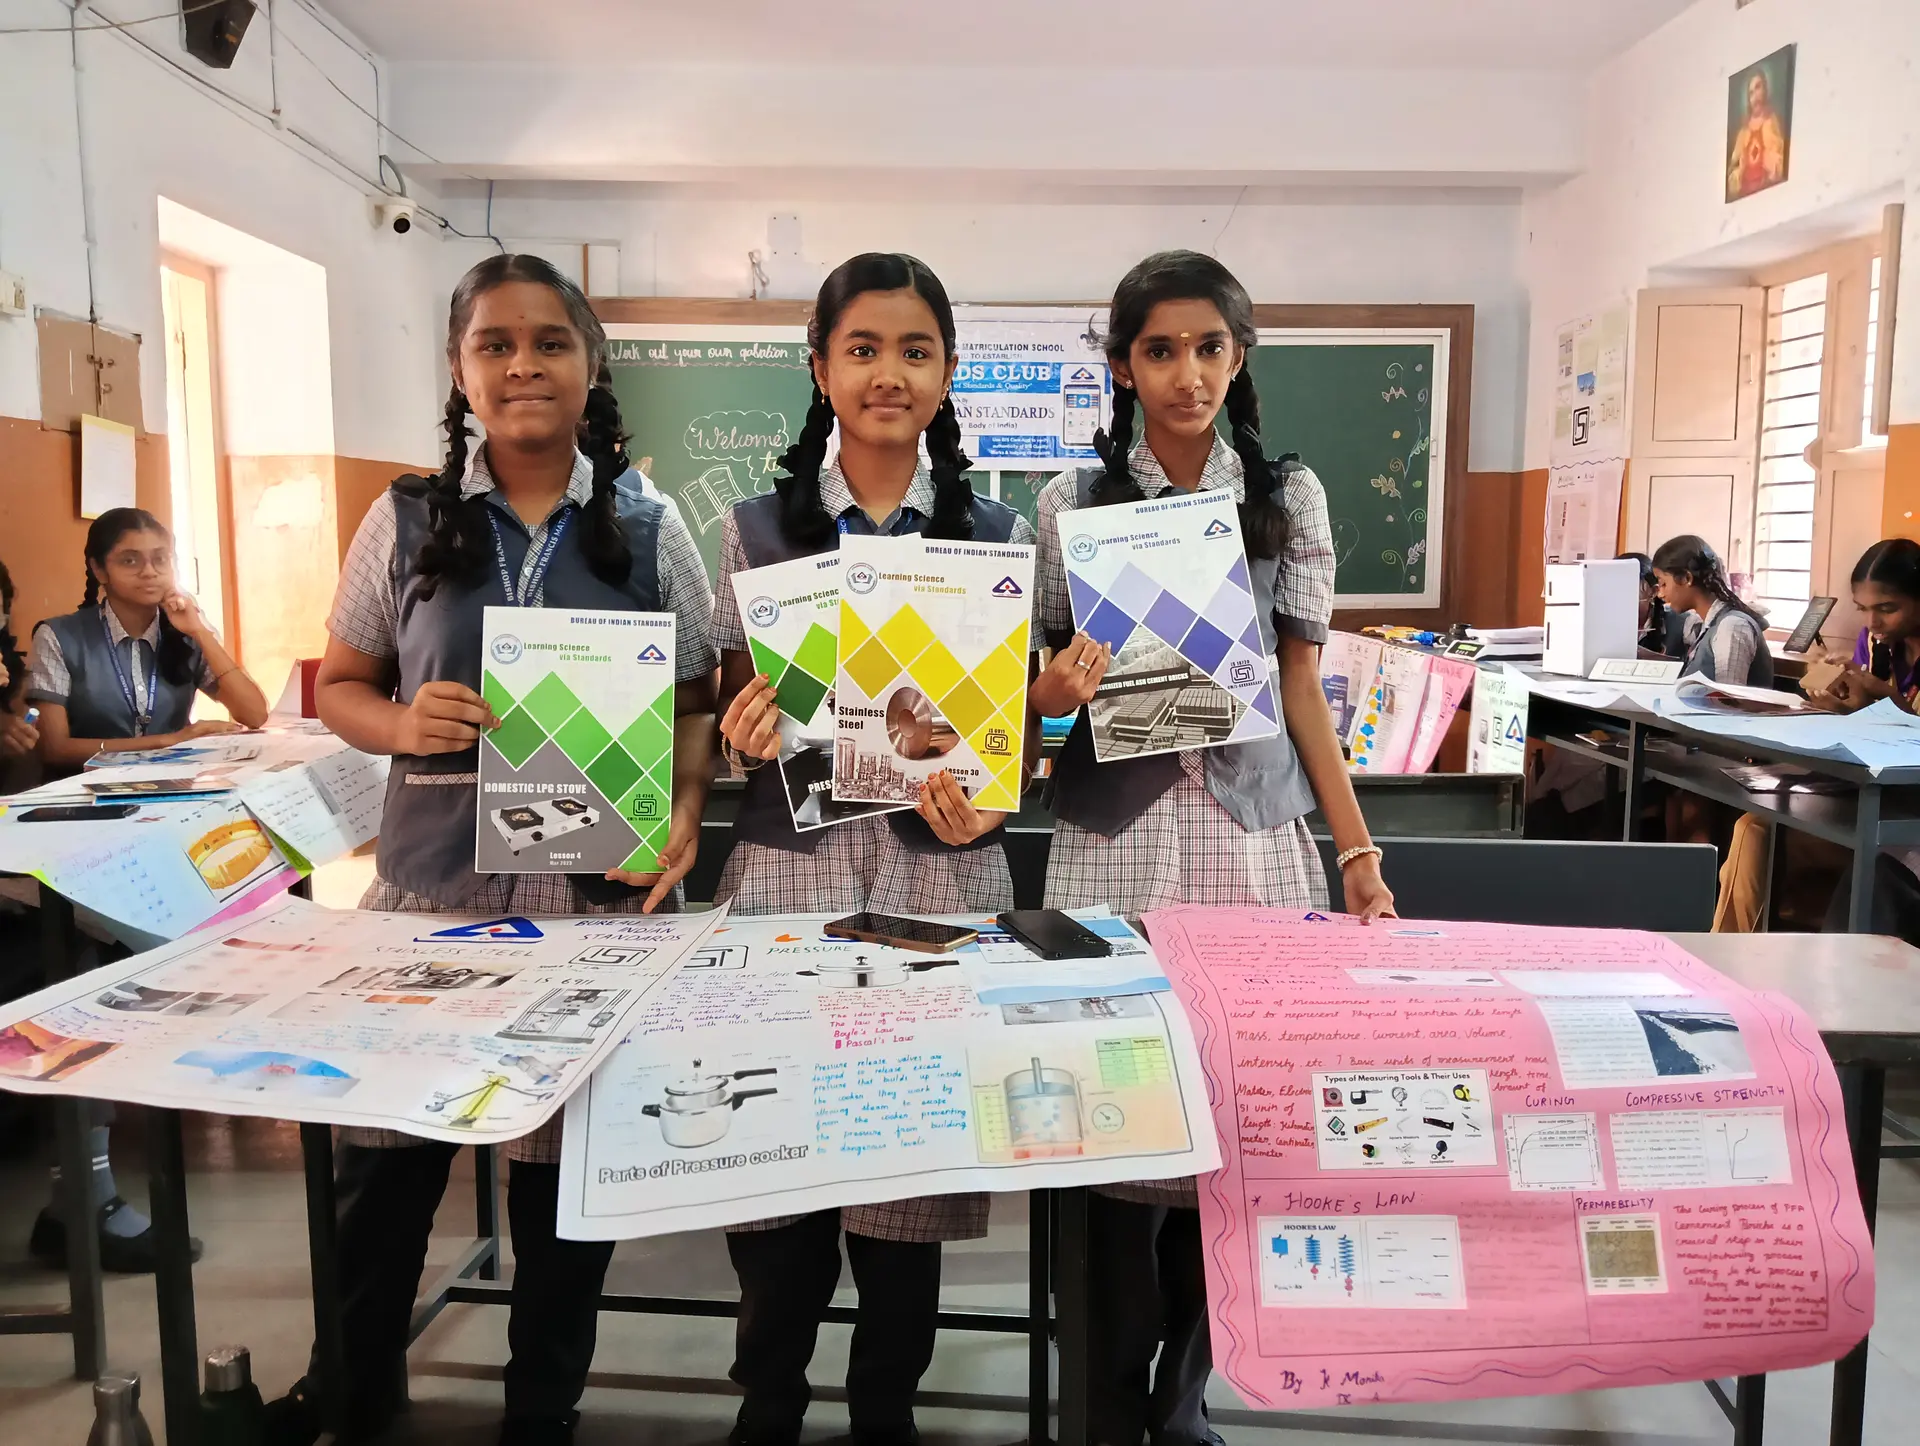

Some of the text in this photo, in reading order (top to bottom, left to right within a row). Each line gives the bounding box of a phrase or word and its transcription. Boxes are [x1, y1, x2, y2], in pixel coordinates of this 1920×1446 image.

[962, 343, 1065, 352] MATRICULATION SCHOOL
[955, 364, 1051, 381] DS CLUB
[955, 406, 1055, 419] AN STANDARDS
[1135, 493, 1231, 514] BUREAU OF INDIAN STANDARDS
[1097, 531, 1159, 547] Learning Science
[1132, 537, 1181, 551] via Standards
[539, 537, 559, 567] FRANCIS
[925, 546, 1030, 559] BUREAU OF INDIAN STANDARDS
[878, 571, 945, 583] Learning Science
[913, 585, 967, 595] via Standards
[778, 588, 839, 608] Learning Scienc
[816, 601, 829, 610] via
[570, 617, 597, 625] BUREAU
[633, 619, 672, 628] STANDARDS
[524, 642, 590, 652] Learning Science
[559, 653, 612, 662] via Standards
[1123, 679, 1136, 688] FUEL
[838, 705, 885, 718] Stainless
[838, 719, 864, 730] Steel
[484, 783, 587, 795] DOMESTIC LPG STOVE
[549, 851, 582, 859] Lesson 4
[574, 920, 641, 928] BUREAU
[617, 926, 676, 934] INDIAN
[578, 933, 683, 942] STANDARDS
[478, 948, 534, 957] STEEL
[766, 944, 853, 956] PRESSURE
[833, 1027, 867, 1040] Boyle's
[846, 1036, 885, 1048] Pascal's
[857, 1057, 887, 1067] release
[1324, 1075, 1347, 1084] Types
[1348, 1074, 1357, 1082] of
[1358, 1073, 1400, 1083] Measuring
[1400, 1073, 1422, 1081] Tools
[1431, 1072, 1451, 1080] Their
[1452, 1072, 1471, 1080] Uses
[1524, 1085, 1786, 1108] CURING COMPRESSIVE STRENGTH
[599, 1144, 809, 1184] Parts of Pressure cooker
[1280, 1370, 1303, 1395] By
